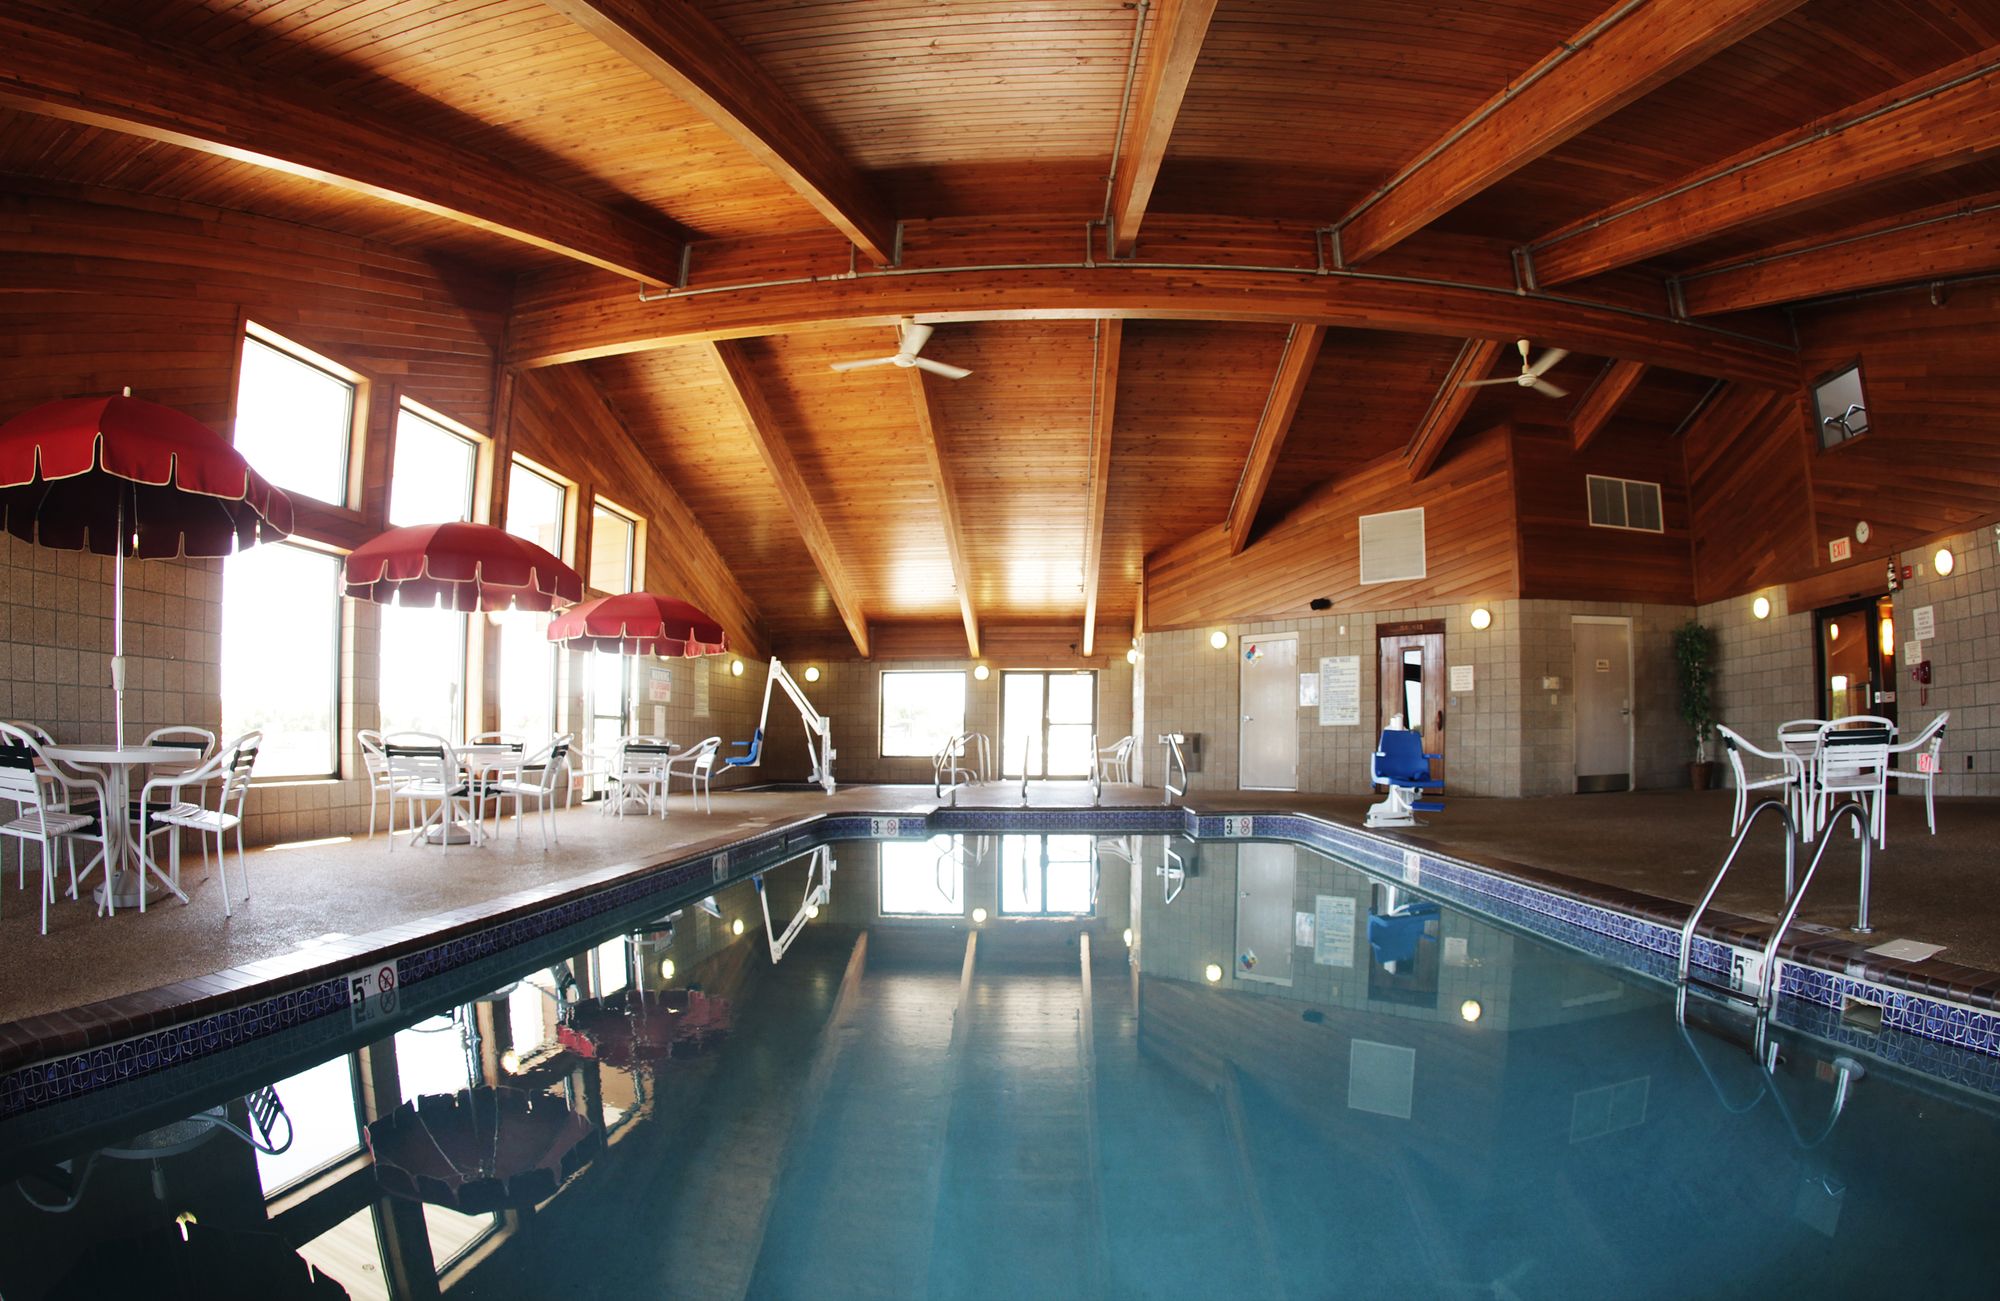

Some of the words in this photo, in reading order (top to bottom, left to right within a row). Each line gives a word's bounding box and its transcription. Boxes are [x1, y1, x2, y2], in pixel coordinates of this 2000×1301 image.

[1832, 540, 1848, 558] EXIT
[1734, 954, 1744, 977] 5
[352, 977, 365, 1004] 5
[364, 974, 372, 986] FT
